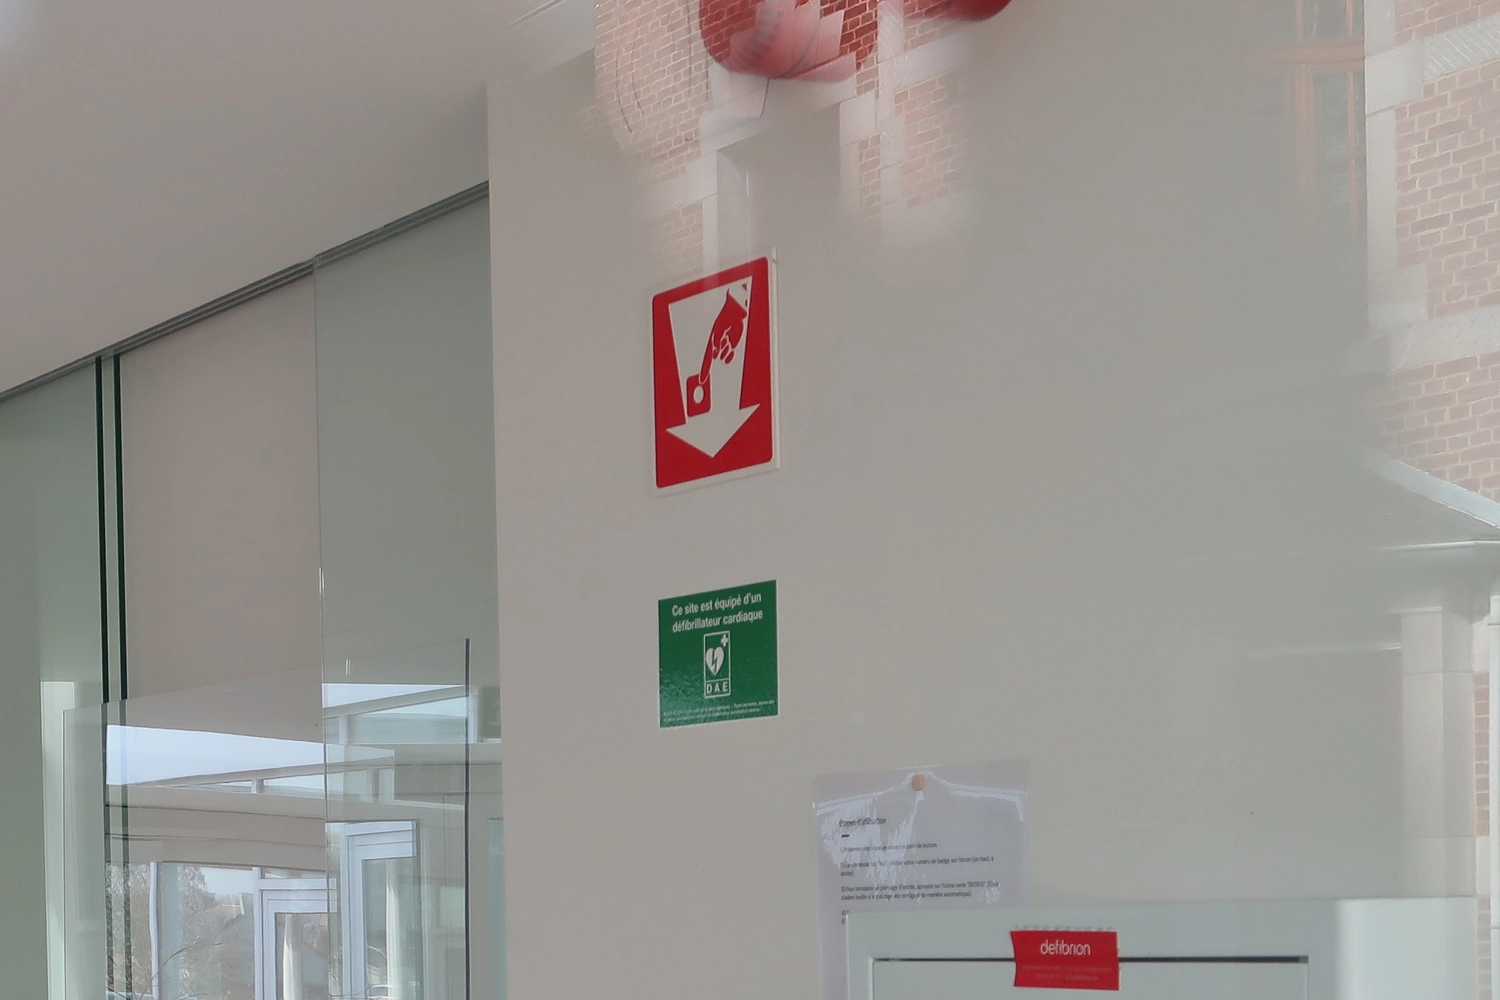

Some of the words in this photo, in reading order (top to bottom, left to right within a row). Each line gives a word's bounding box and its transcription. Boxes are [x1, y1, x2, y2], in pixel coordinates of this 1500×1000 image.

[672, 605, 683, 617] Ce
[684, 602, 699, 615] site
[700, 599, 713, 612] est
[714, 594, 742, 611] équipé
[743, 592, 762, 604] d'un
[672, 616, 722, 633] défibrillateur
[723, 610, 763, 625] cardiaque
[706, 681, 728, 694] DAE
[1040, 939, 1091, 955] defibrion
